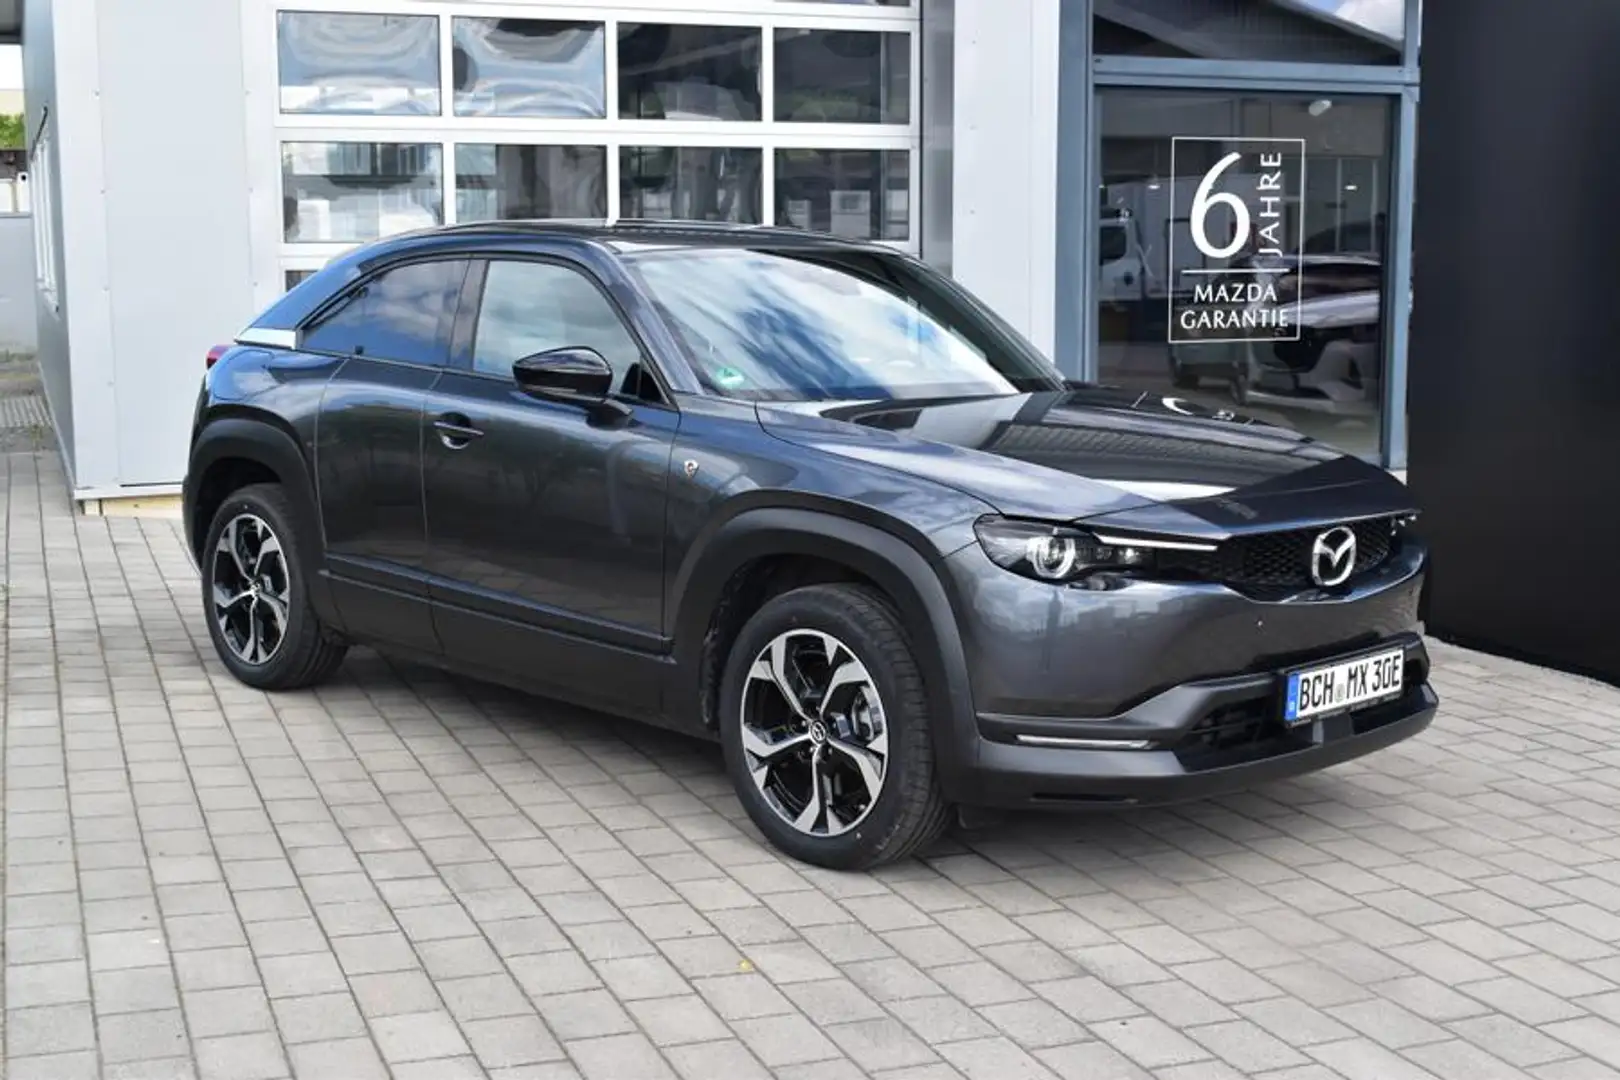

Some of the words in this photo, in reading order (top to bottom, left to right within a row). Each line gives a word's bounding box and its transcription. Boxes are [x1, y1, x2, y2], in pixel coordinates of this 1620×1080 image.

[1190, 152, 1250, 258] 6
[1256, 152, 1283, 258] JAHRE
[1194, 283, 1277, 303] MAZDA
[1180, 308, 1289, 329] GARANTIE
[1300, 671, 1335, 711] BCH
[1346, 662, 1369, 699] MX
